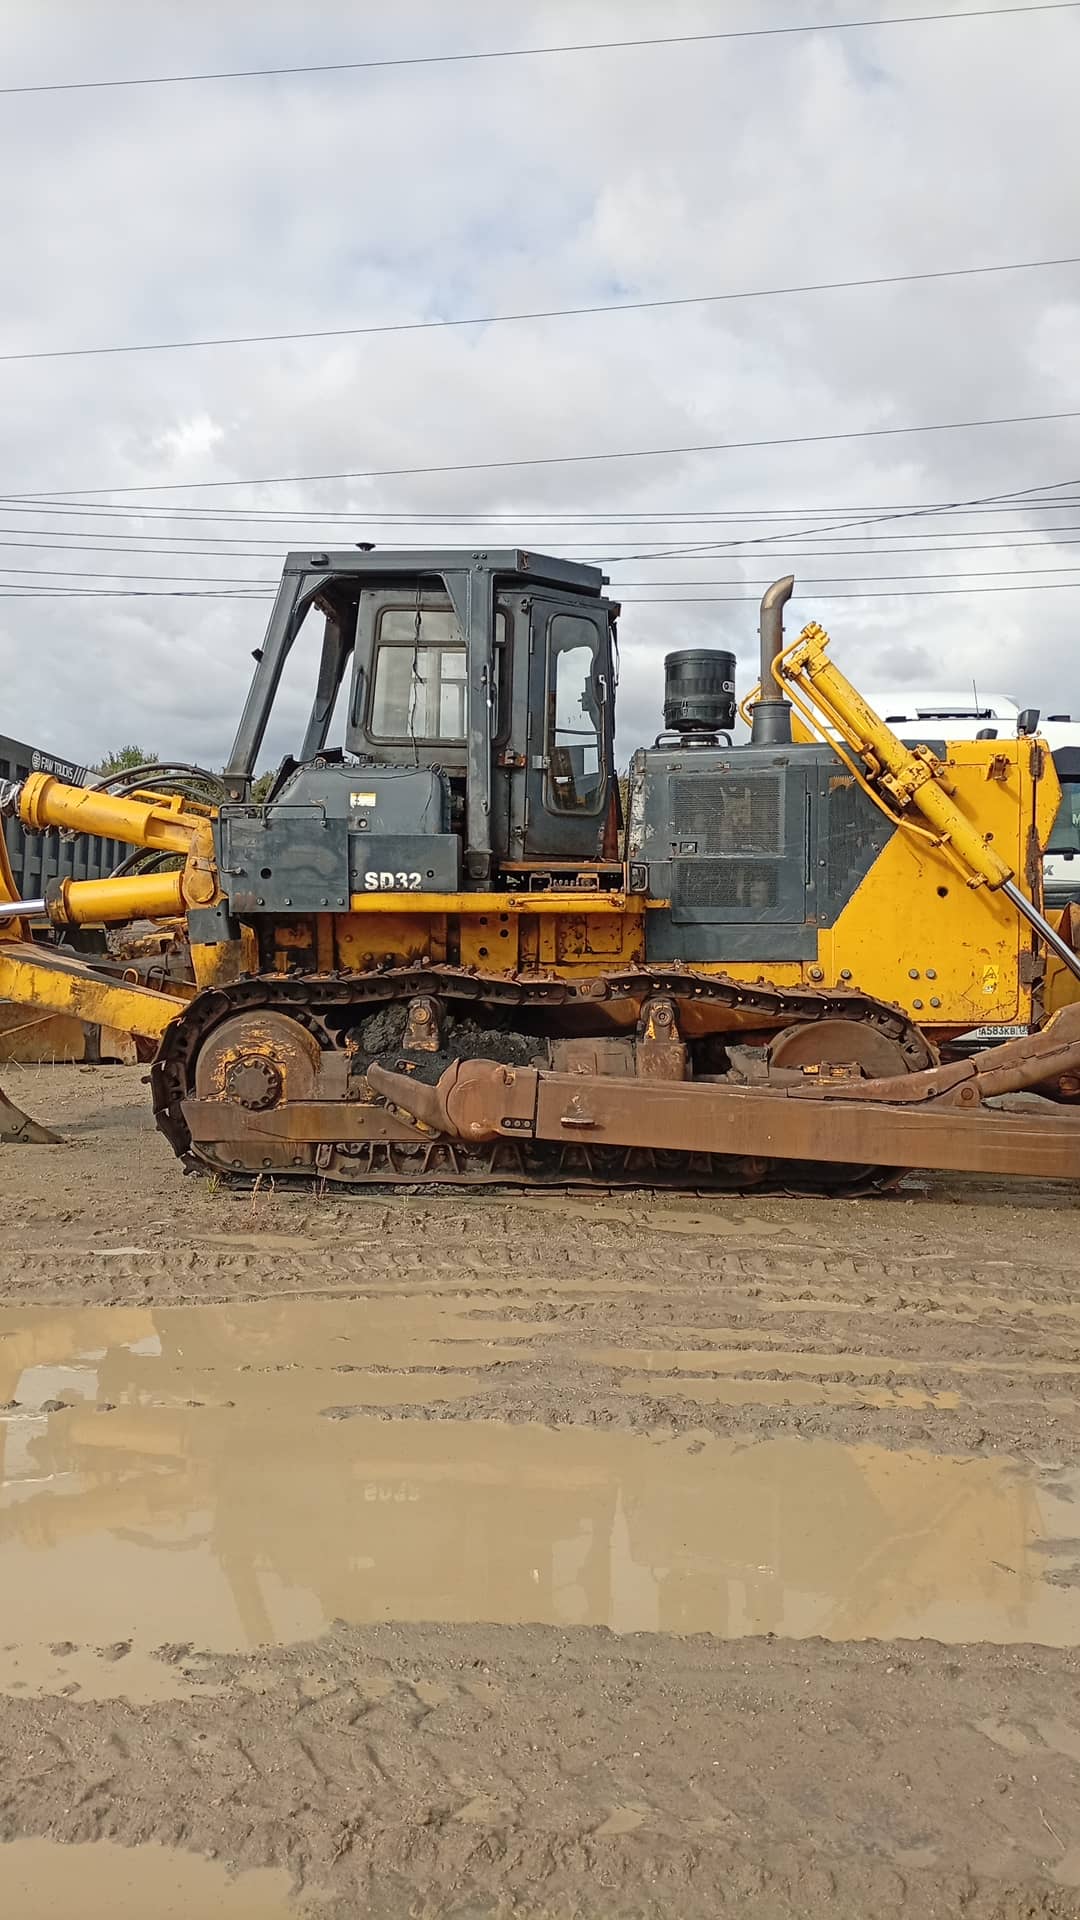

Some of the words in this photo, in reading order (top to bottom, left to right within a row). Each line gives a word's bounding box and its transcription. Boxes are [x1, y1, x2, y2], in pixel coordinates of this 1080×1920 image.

[41, 756, 54, 771] FAW
[54, 761, 74, 779] TRUCKS
[364, 871, 422, 890] SD32
